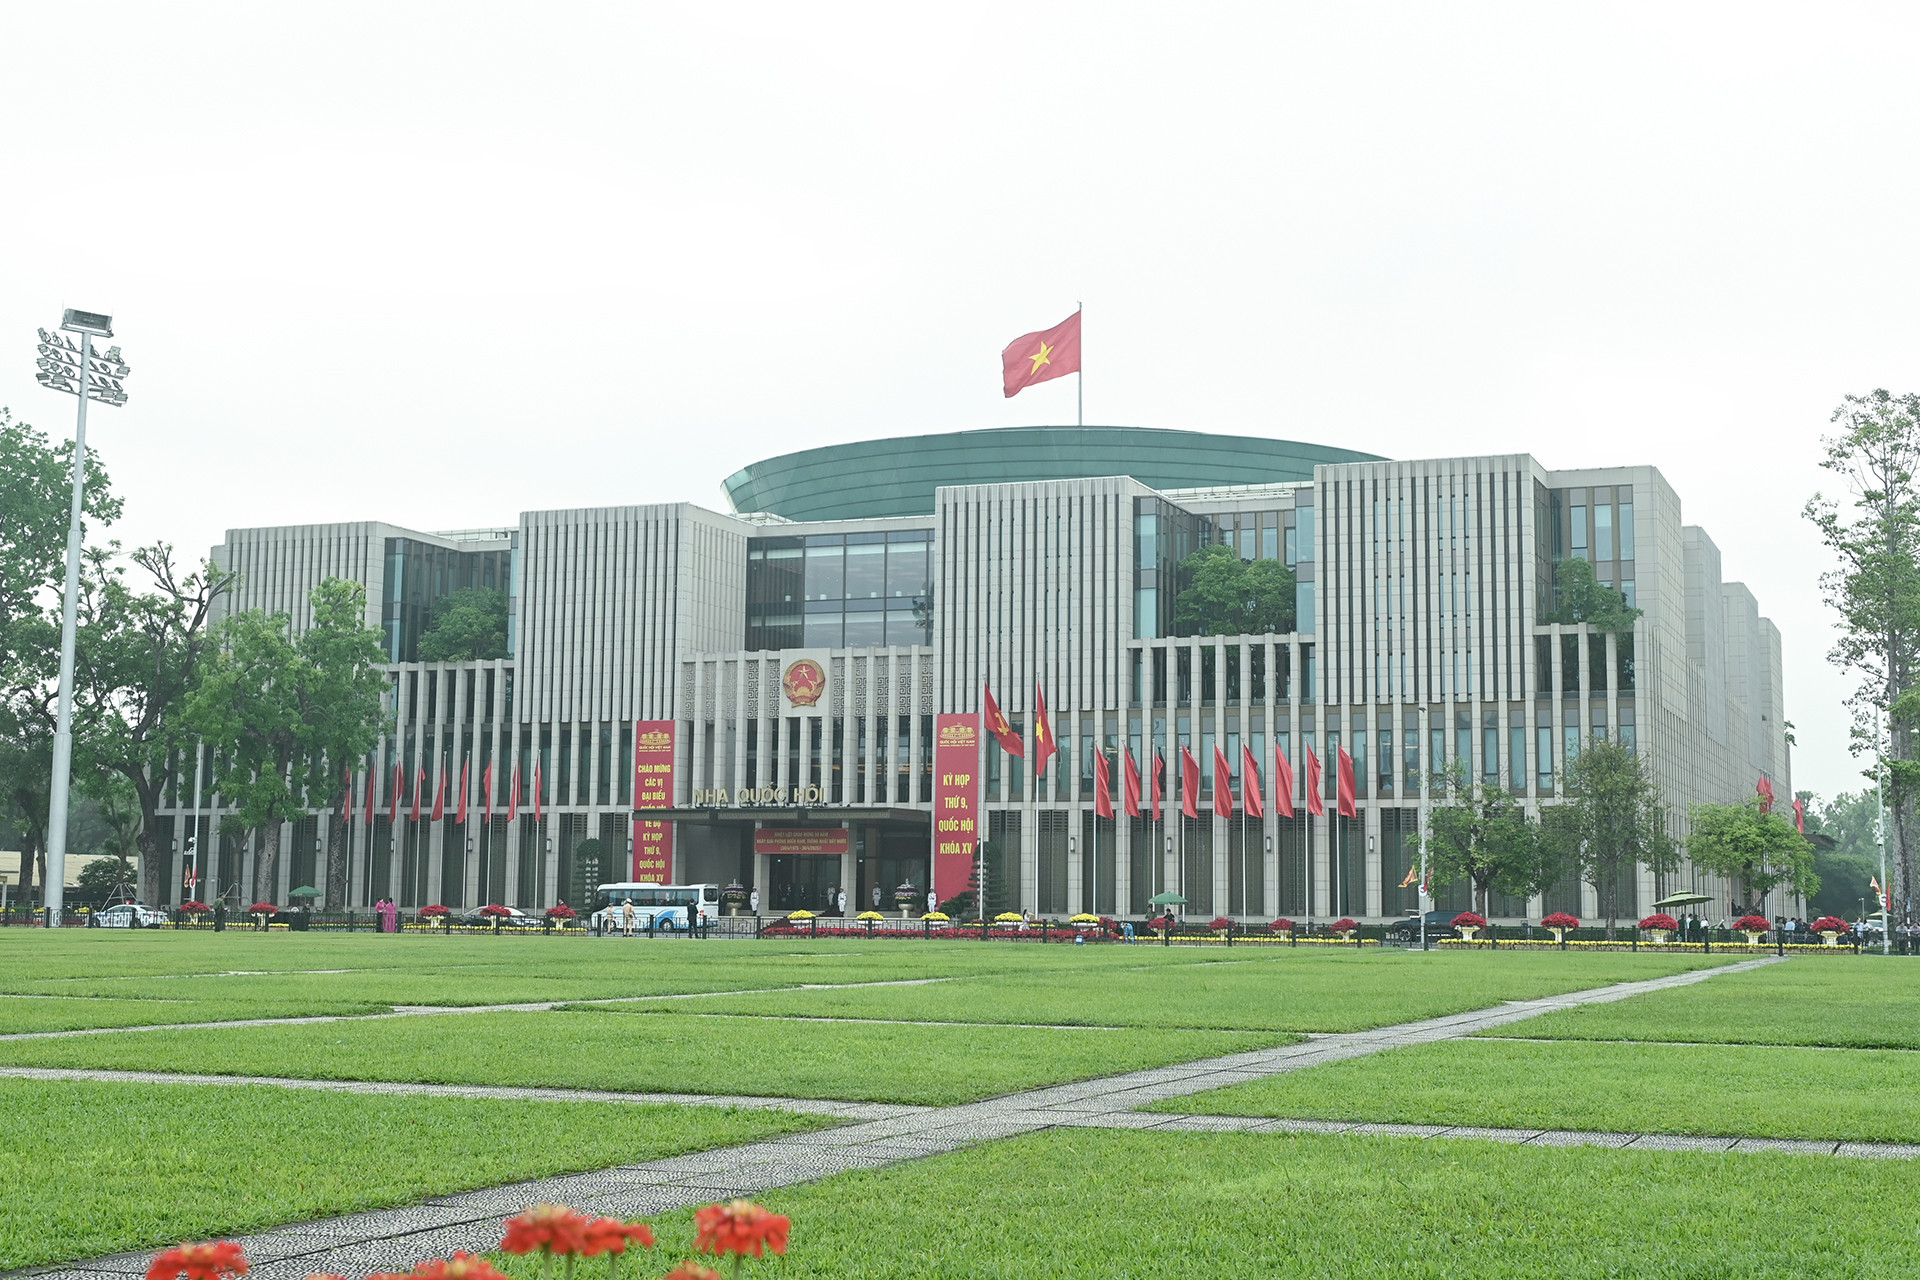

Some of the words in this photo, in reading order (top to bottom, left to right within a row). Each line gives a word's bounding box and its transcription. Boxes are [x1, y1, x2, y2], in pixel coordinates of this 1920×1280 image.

[645, 777, 656, 786] CÁC
[657, 778, 663, 788] VỊ
[943, 771, 953, 786] KỲ
[955, 774, 970, 788] HỌP
[738, 782, 786, 802] QUỐC
[945, 794, 960, 808] THỨ
[961, 797, 968, 810] 9,
[939, 816, 959, 832] QUỐC
[961, 817, 973, 834] HỘI
[643, 832, 650, 841] KỲ
[940, 840, 960, 854] KHÓA
[962, 843, 972, 854] XV
[639, 858, 654, 869] QUỐC
